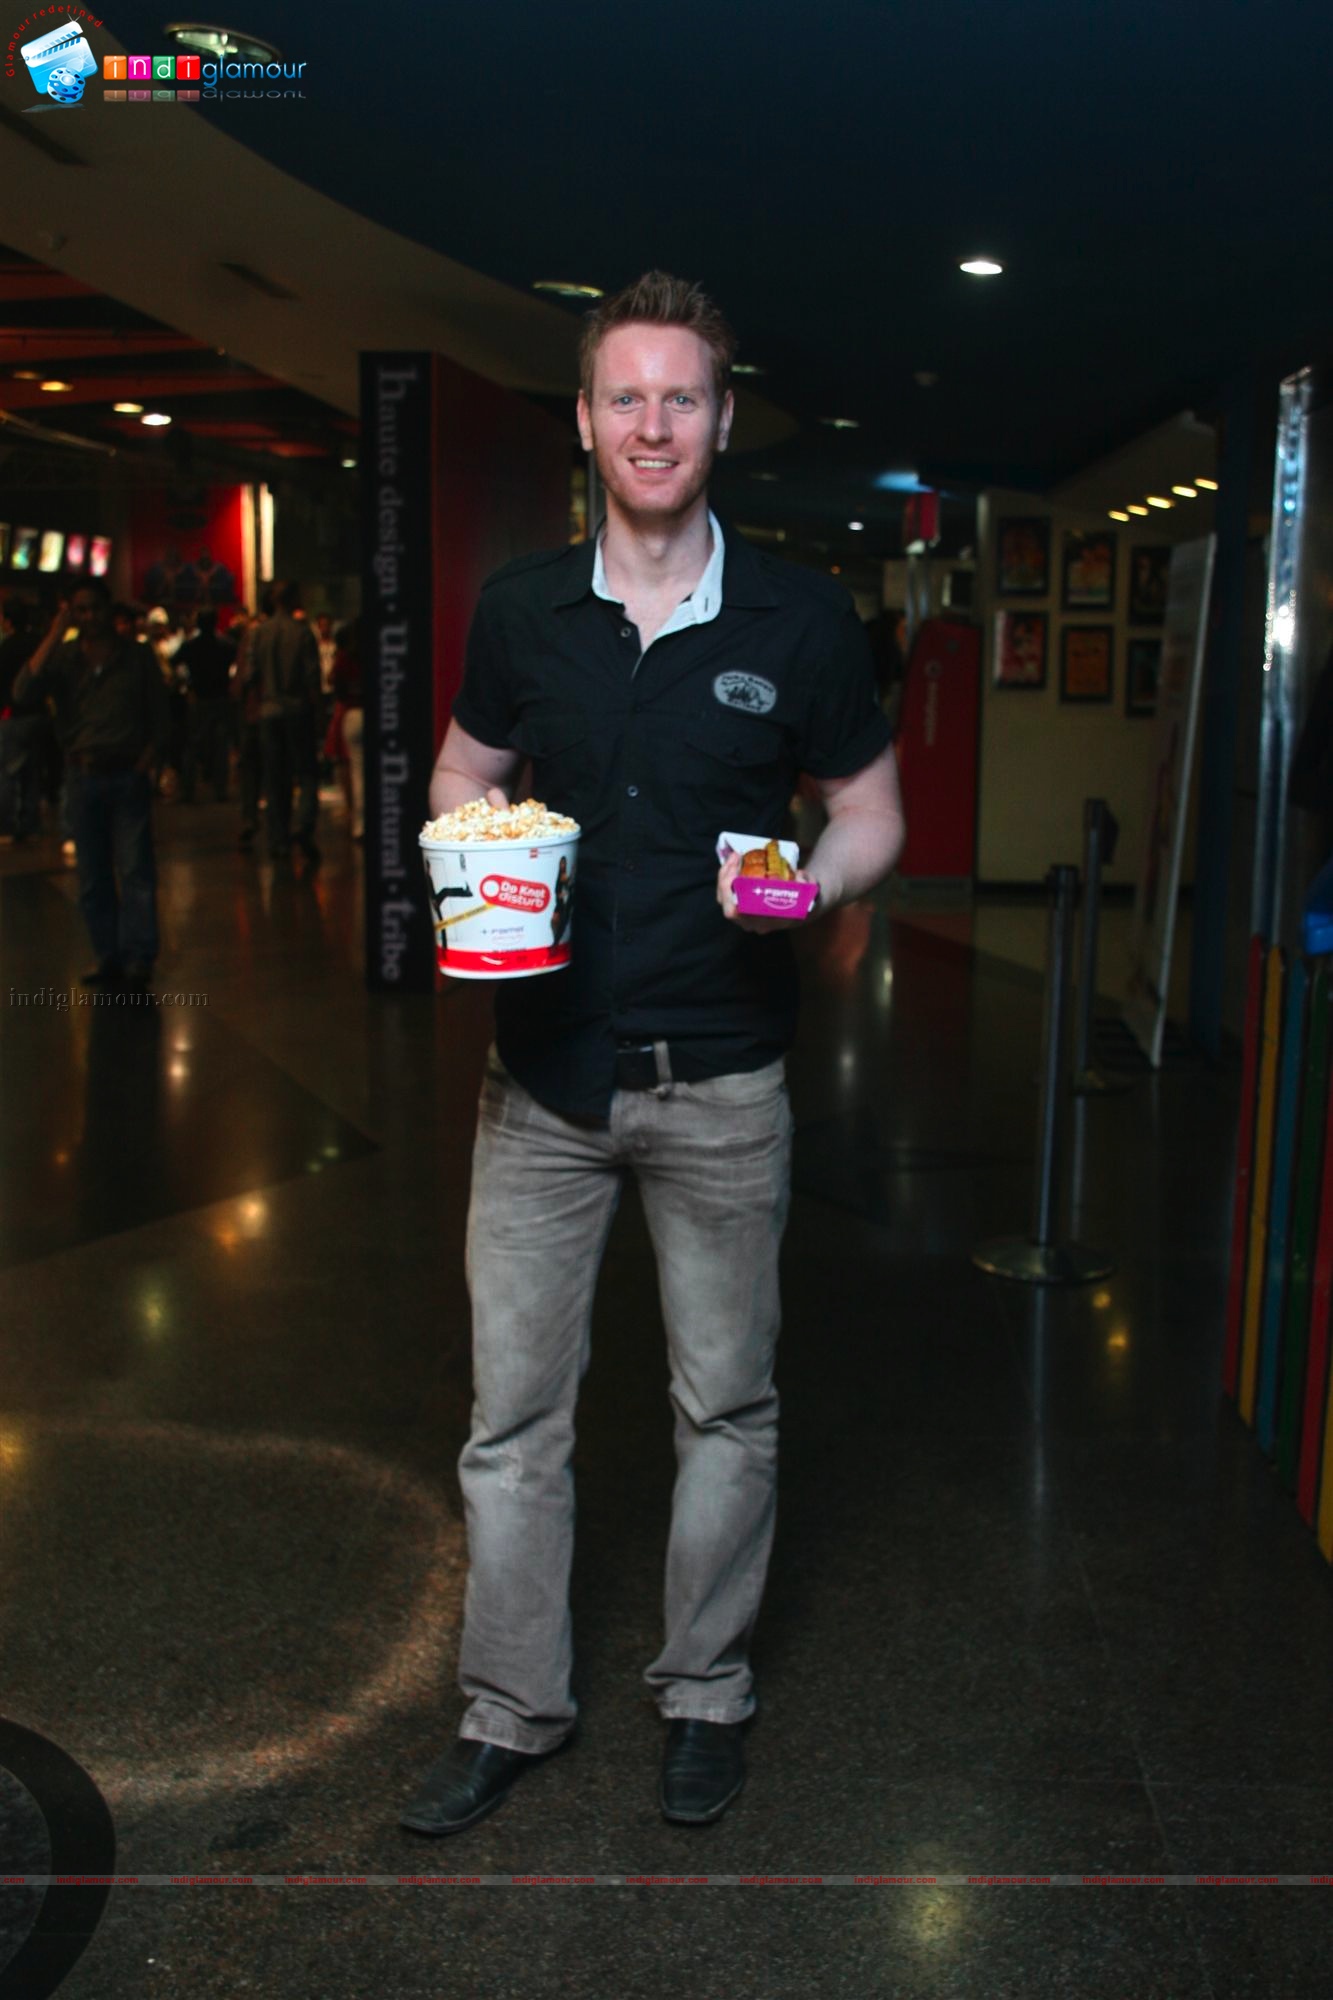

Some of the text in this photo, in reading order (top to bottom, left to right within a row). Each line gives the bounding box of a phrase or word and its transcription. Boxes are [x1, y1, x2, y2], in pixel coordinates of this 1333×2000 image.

[377, 367, 419, 476] haute
[373, 485, 406, 598] design
[381, 897, 418, 982] tribe
